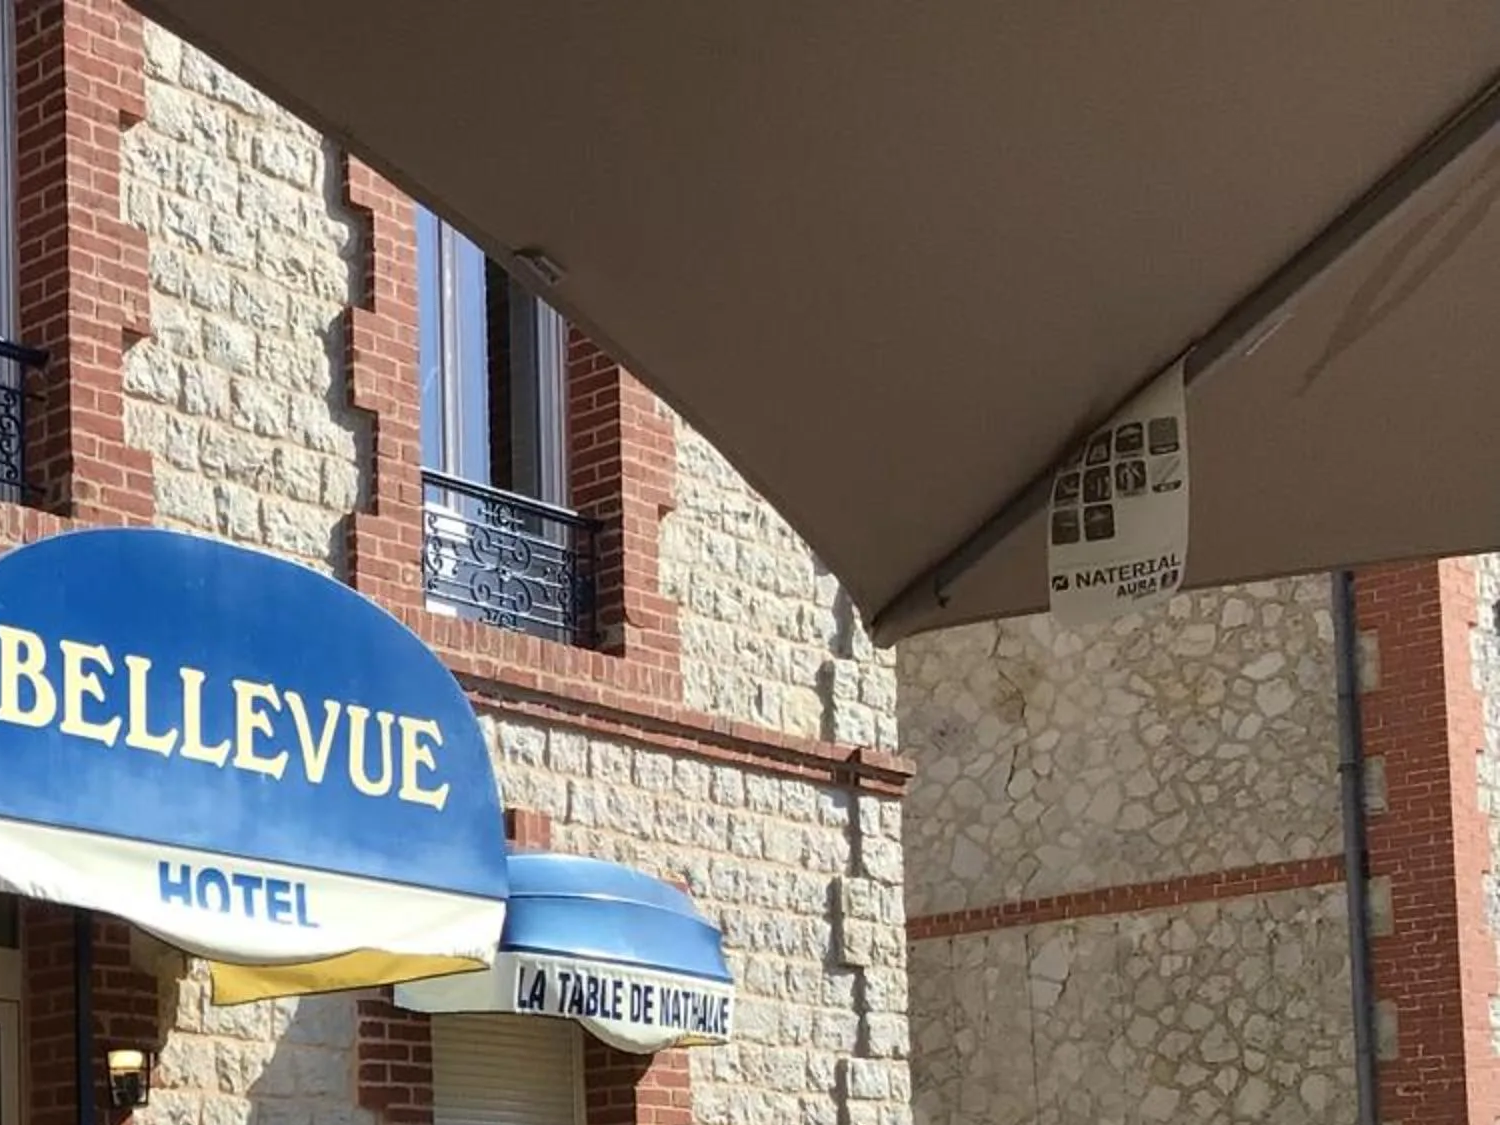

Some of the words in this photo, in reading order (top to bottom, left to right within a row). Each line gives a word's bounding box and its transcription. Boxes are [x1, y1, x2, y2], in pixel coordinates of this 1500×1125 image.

[1075, 552, 1181, 588] NATERIAL
[157, 860, 321, 929] HOTEL
[516, 966, 547, 1011] LA
[557, 972, 624, 1021] TABLE
[629, 983, 655, 1025] DE
